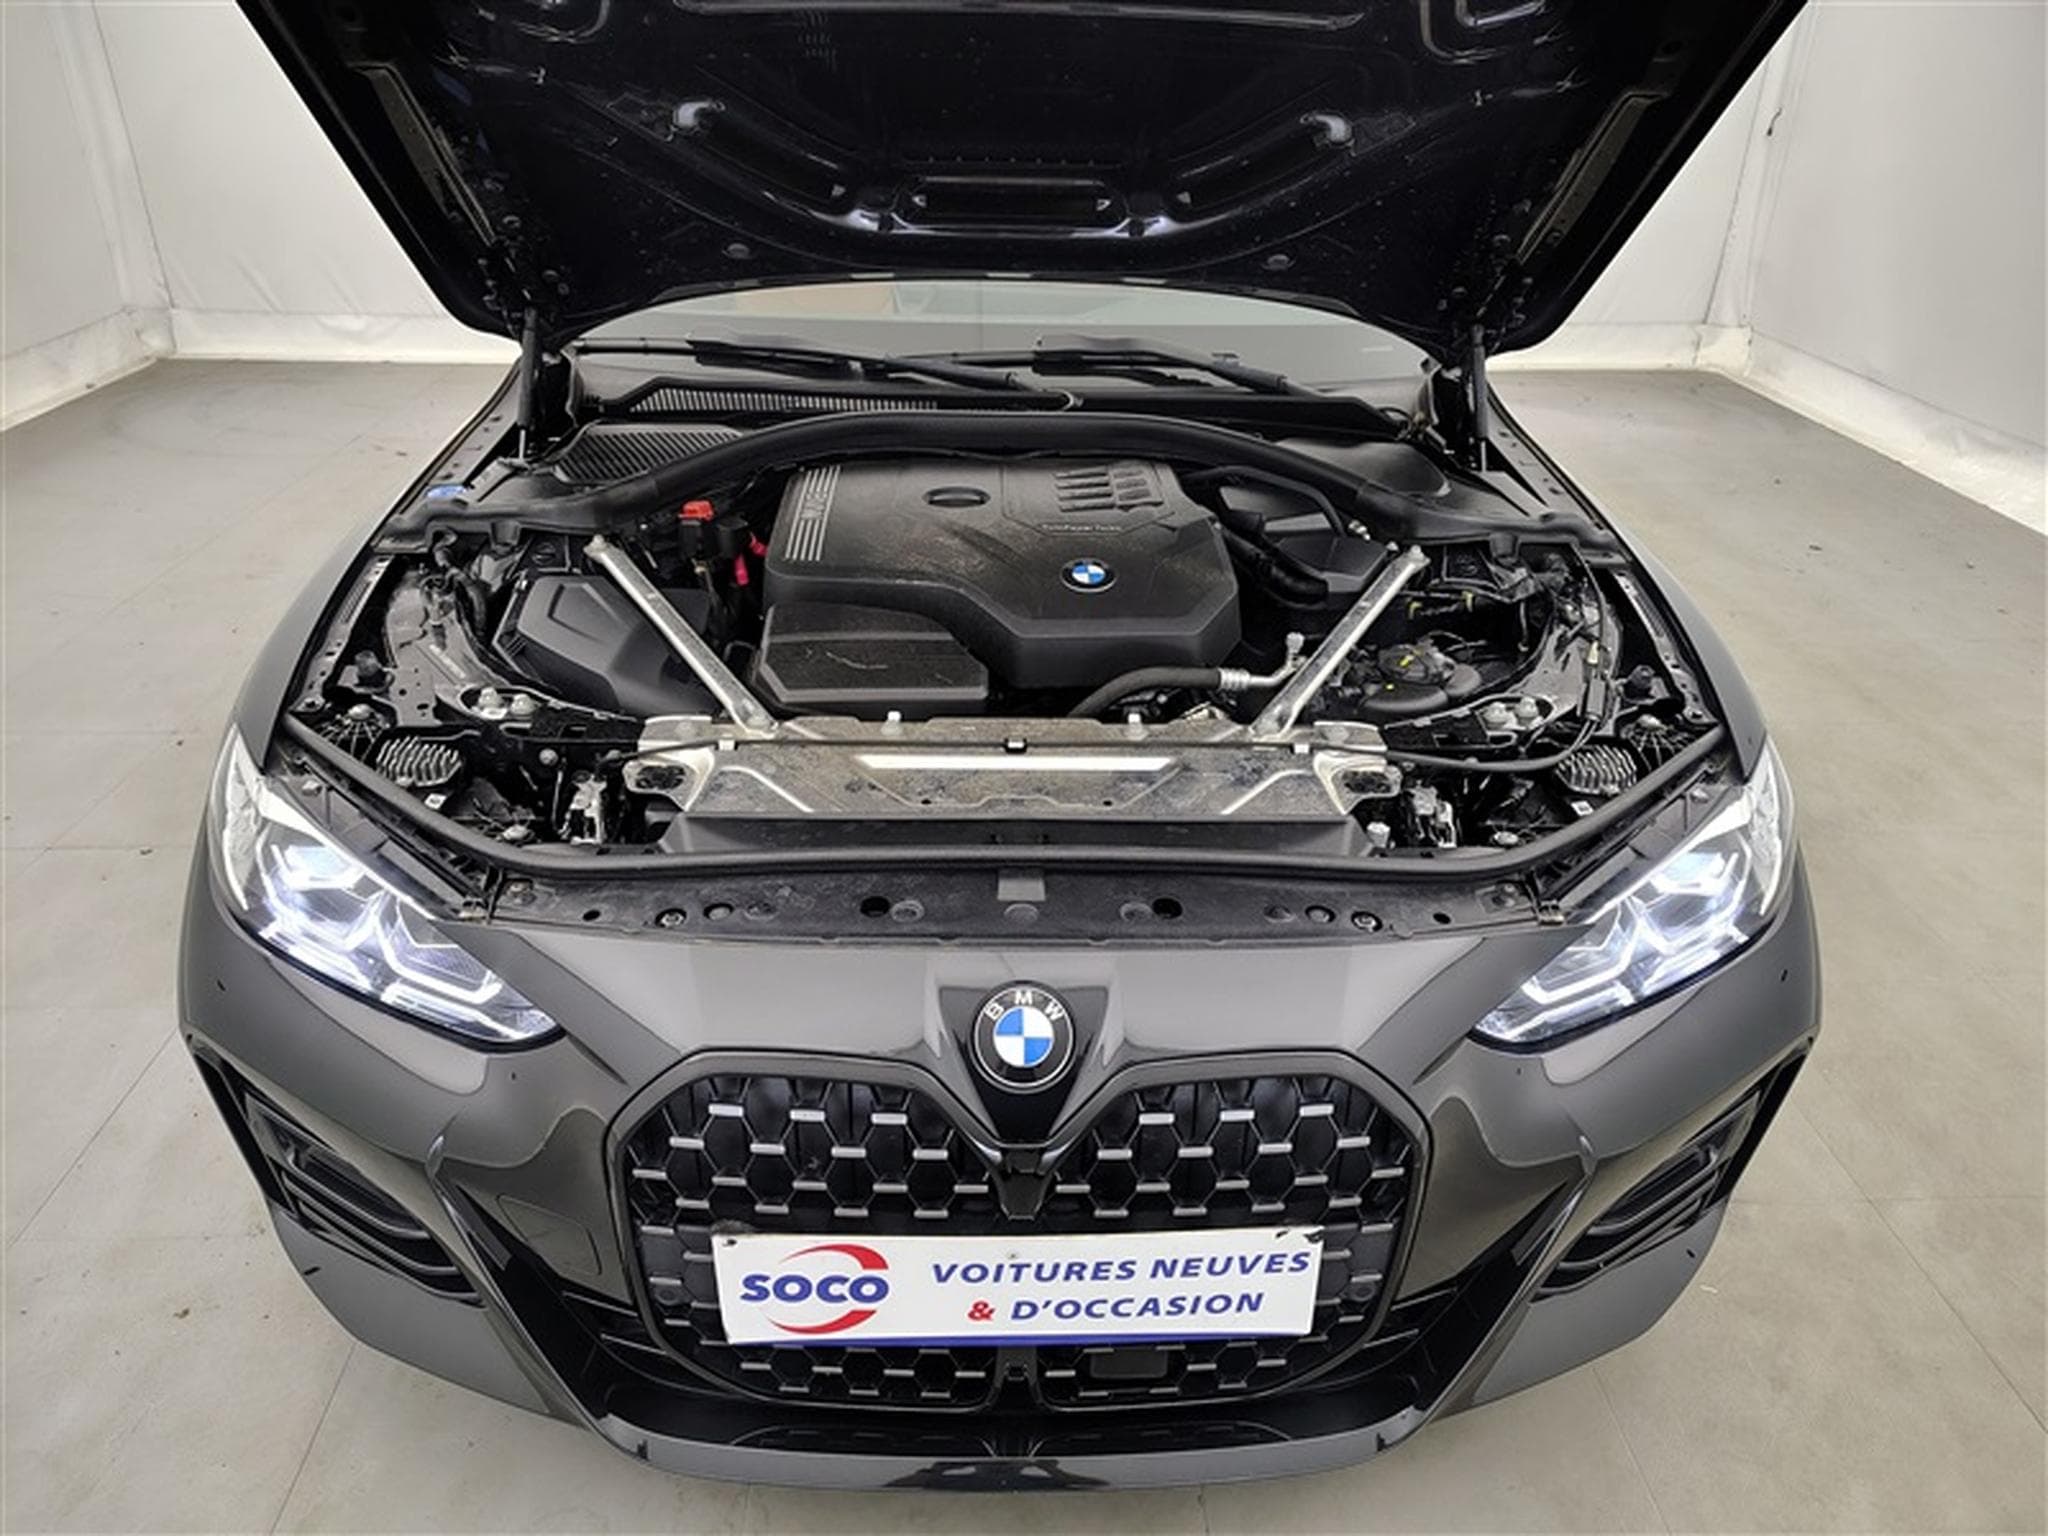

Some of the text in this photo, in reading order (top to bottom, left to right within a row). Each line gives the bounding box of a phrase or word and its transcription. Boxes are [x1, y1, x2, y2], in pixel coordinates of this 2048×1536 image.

[983, 989, 1065, 1021] BMW
[932, 1251, 1311, 1284] VOITURES NEUVES
[740, 1273, 889, 1304] SOCO
[967, 1300, 996, 1322] &
